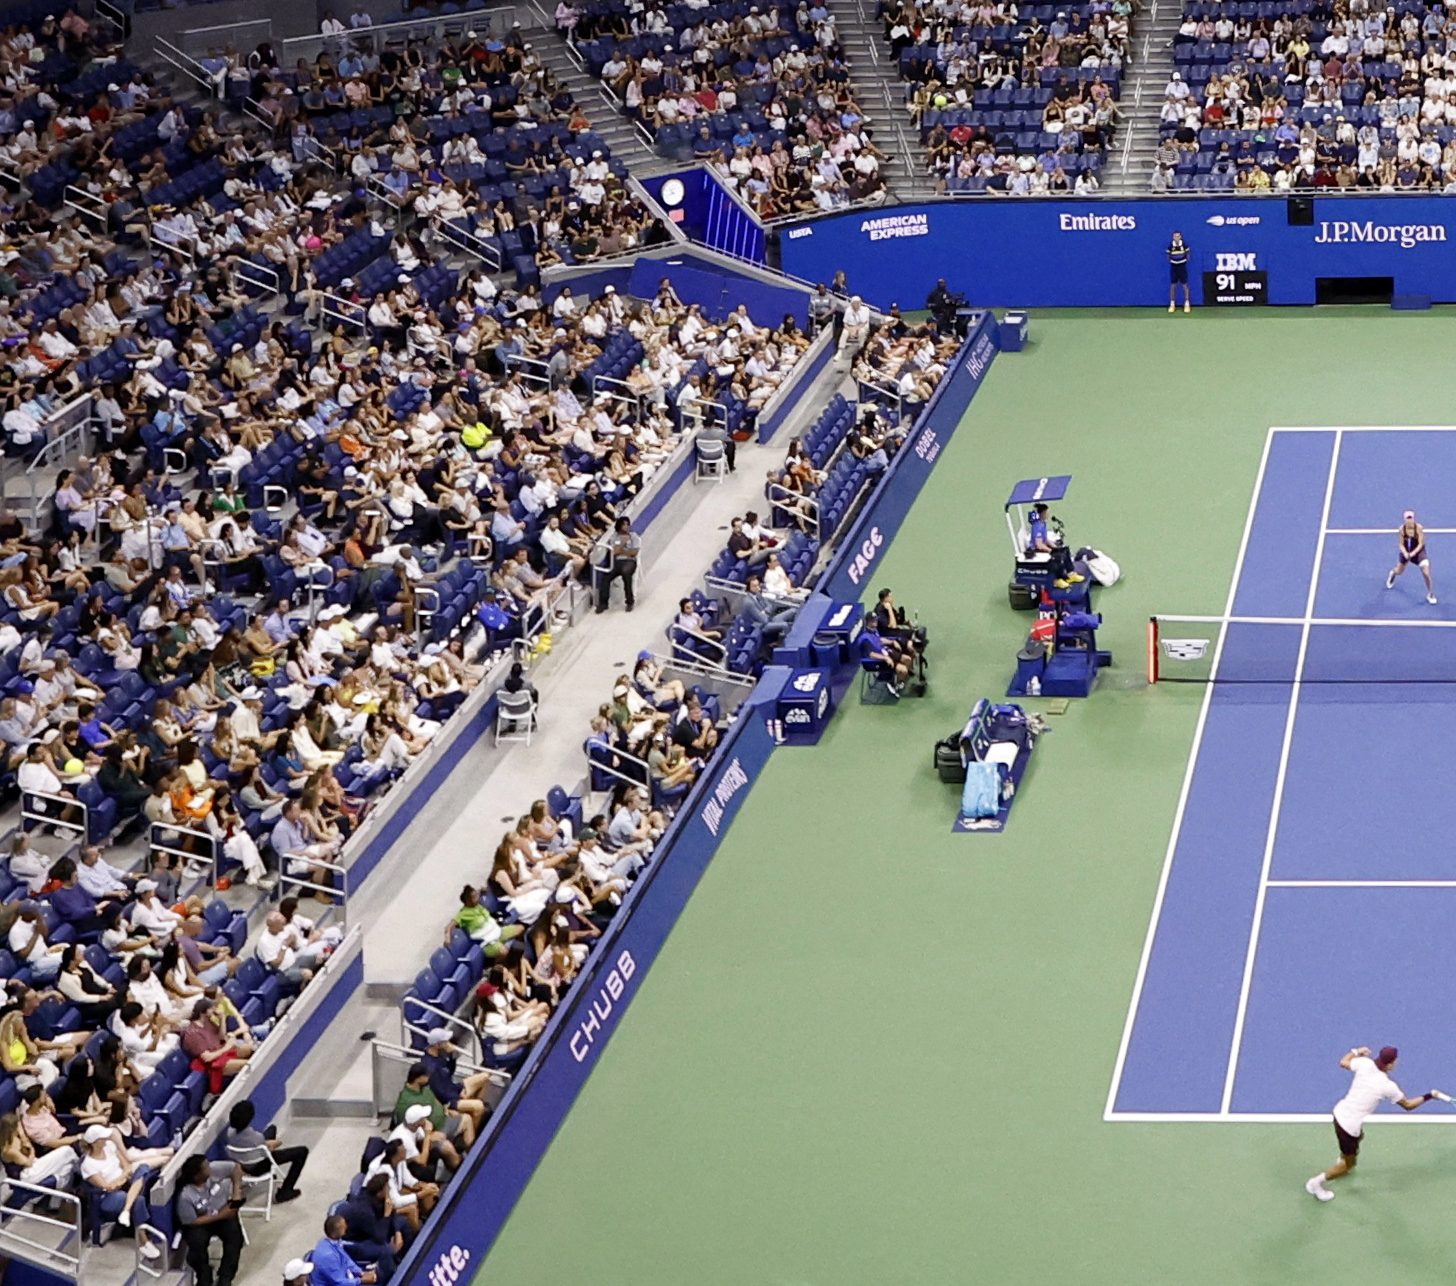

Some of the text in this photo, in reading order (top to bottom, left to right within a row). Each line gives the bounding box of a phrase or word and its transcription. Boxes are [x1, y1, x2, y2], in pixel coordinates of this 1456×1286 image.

[860, 214, 928, 233] AMERICAN
[1060, 213, 1135, 230] Emirates
[789, 227, 813, 239] USTA
[869, 224, 929, 241] EXPRESS
[1315, 222, 1446, 248] J.P.Morgan
[1216, 253, 1256, 271] IBM
[1216, 274, 1234, 290] 91
[965, 351, 984, 380] IHG
[847, 527, 883, 585] FAGE
[569, 949, 636, 1062] CHUBB
